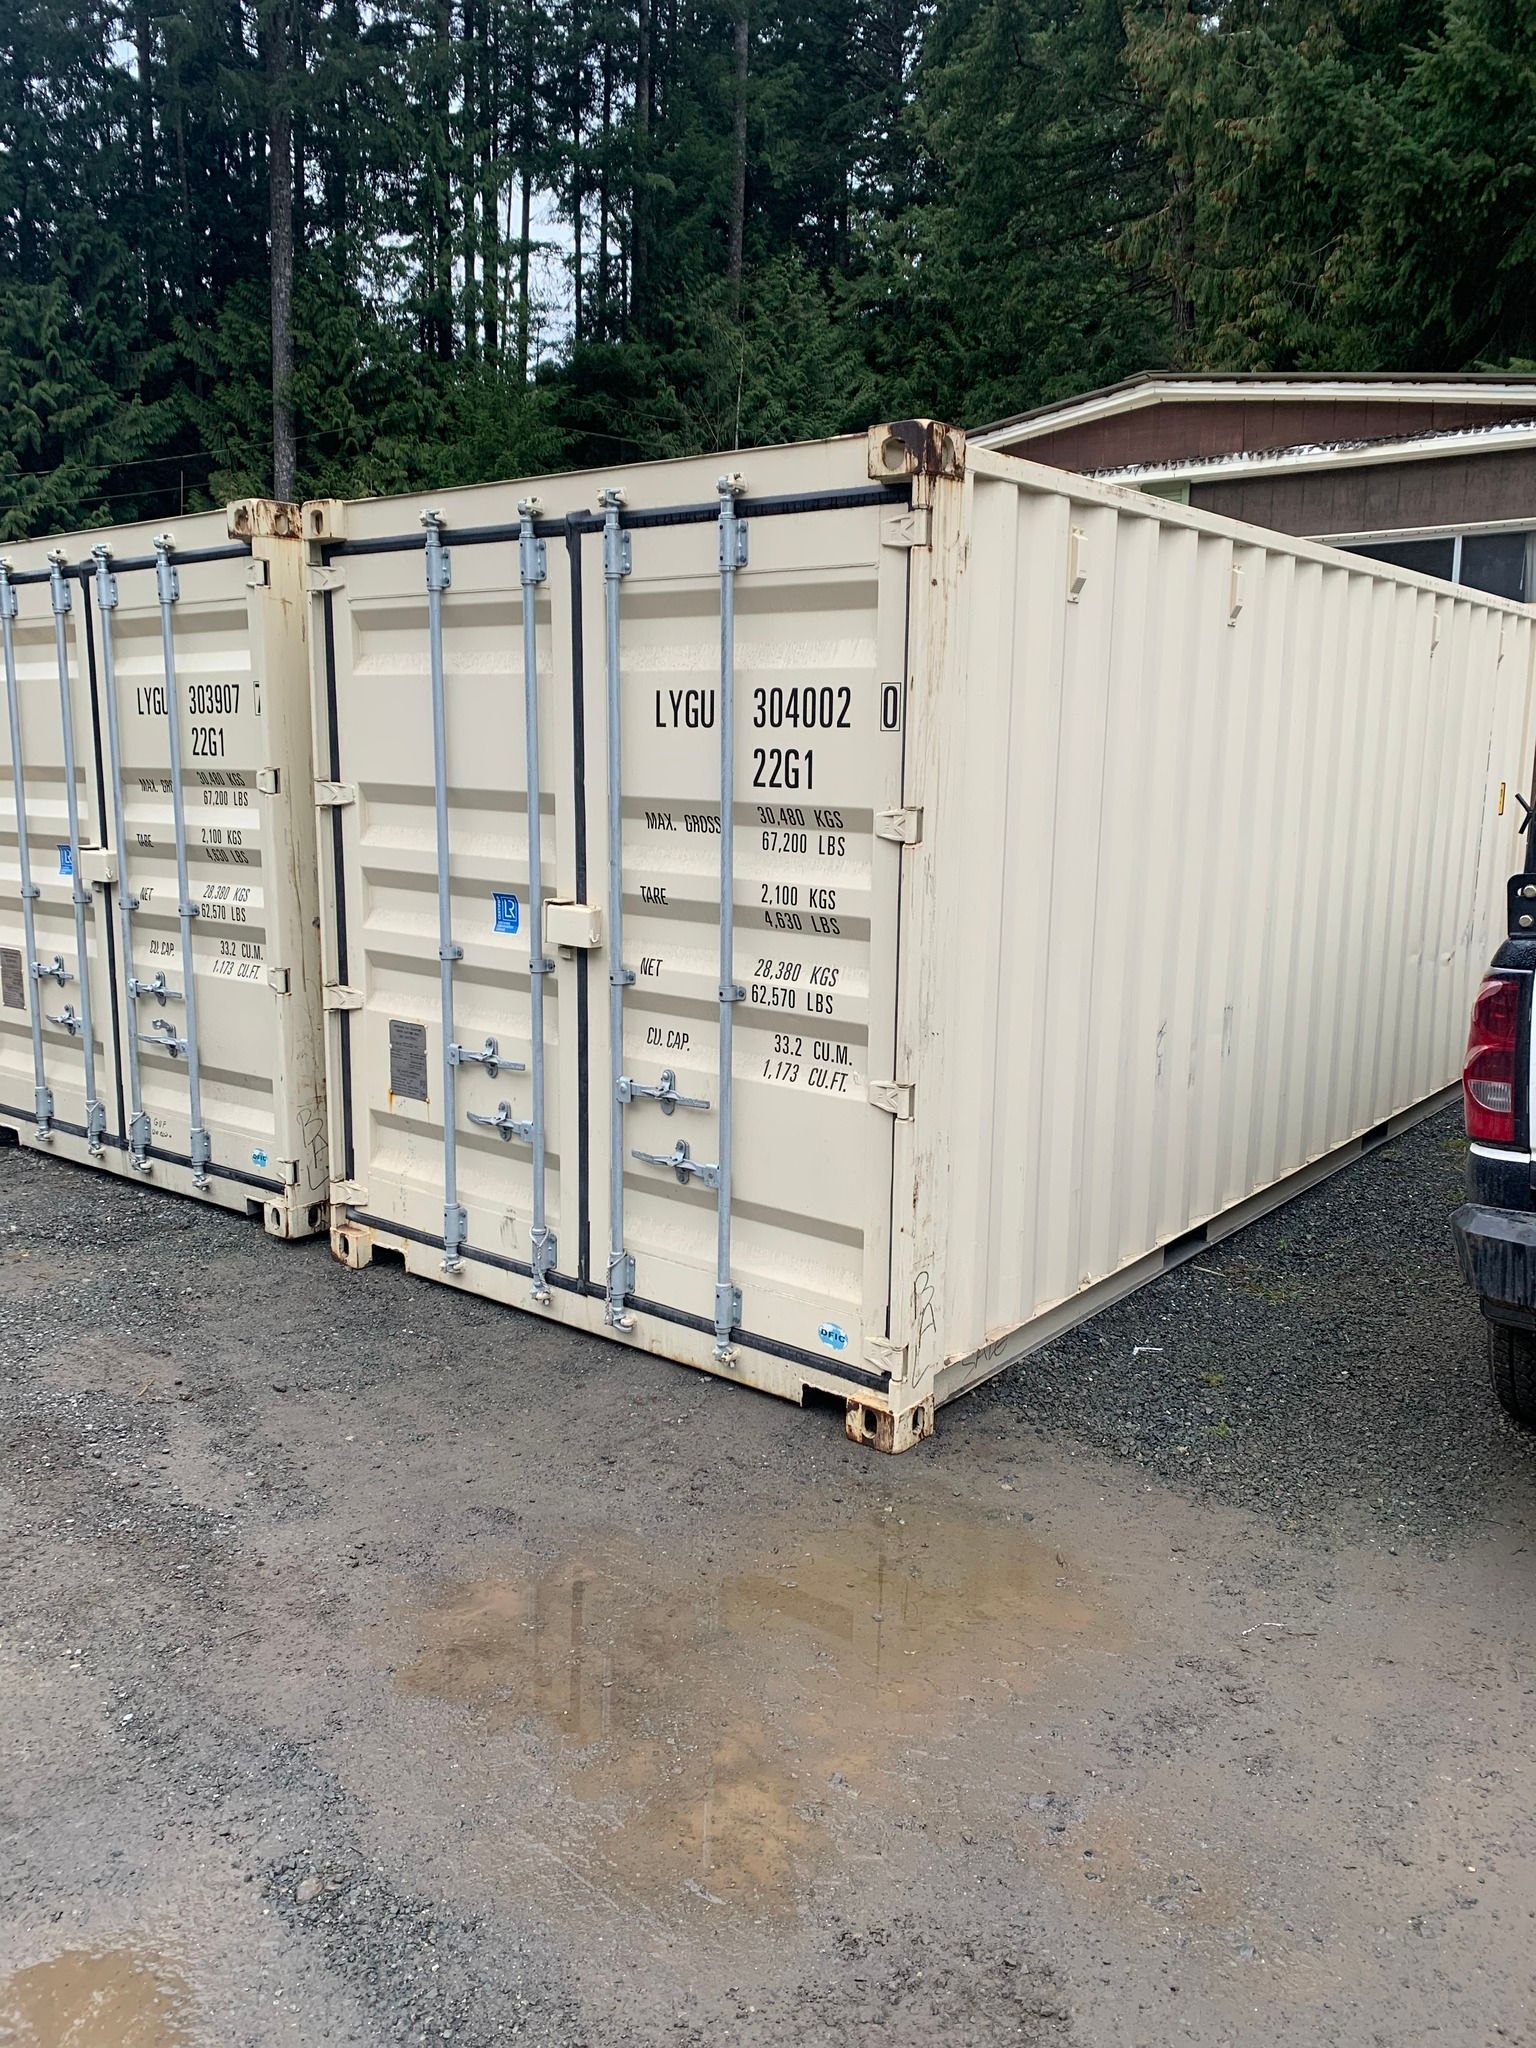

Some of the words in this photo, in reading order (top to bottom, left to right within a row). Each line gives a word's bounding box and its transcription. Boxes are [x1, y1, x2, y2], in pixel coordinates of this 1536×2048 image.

[188, 684, 240, 714] 303907
[655, 689, 715, 728] LYGU
[753, 687, 851, 728] 304002
[883, 686, 898, 728] 0
[191, 727, 225, 757] 22G1
[138, 777, 159, 793] MAX.
[196, 771, 225, 786] 30,480
[226, 772, 246, 786] KGS
[753, 748, 814, 790] 22G1
[203, 790, 228, 806] 67,200
[233, 791, 249, 807] LBS
[645, 811, 677, 832] MAX.
[684, 814, 721, 834] GROSS
[757, 806, 805, 827] 30,480
[813, 809, 844, 829] KGS
[136, 833, 155, 848] TARE
[201, 828, 222, 844] 2,100
[227, 830, 242, 846] KGS
[762, 831, 807, 854] 67,200
[819, 835, 845, 857] LBS
[206, 848, 229, 862] 4,630
[231, 849, 249, 864] LBS
[139, 887, 154, 901] NET
[202, 884, 231, 900] 28,380
[232, 887, 251, 902] KGS
[640, 885, 668, 905] TARE
[761, 884, 798, 906] 2,100
[809, 888, 836, 910] KGS
[201, 903, 226, 920] 62,570
[231, 907, 246, 923] LBS
[765, 911, 803, 930] 4,630
[811, 915, 841, 935] LBS
[220, 940, 236, 957] 33.2
[241, 943, 264, 961] CU.M.
[237, 963, 261, 980] CU.FT.
[640, 957, 663, 977] NET
[754, 959, 802, 982] 28,380
[809, 966, 839, 987] KGS
[751, 984, 796, 1009] 62,570
[807, 992, 834, 1015] LBS
[774, 1034, 803, 1057] 33.2
[813, 1041, 853, 1066] CU.M.
[763, 1059, 800, 1083] 1,173
[808, 1067, 849, 1093] CU.FT.
[820, 1328, 846, 1344] DFIC
